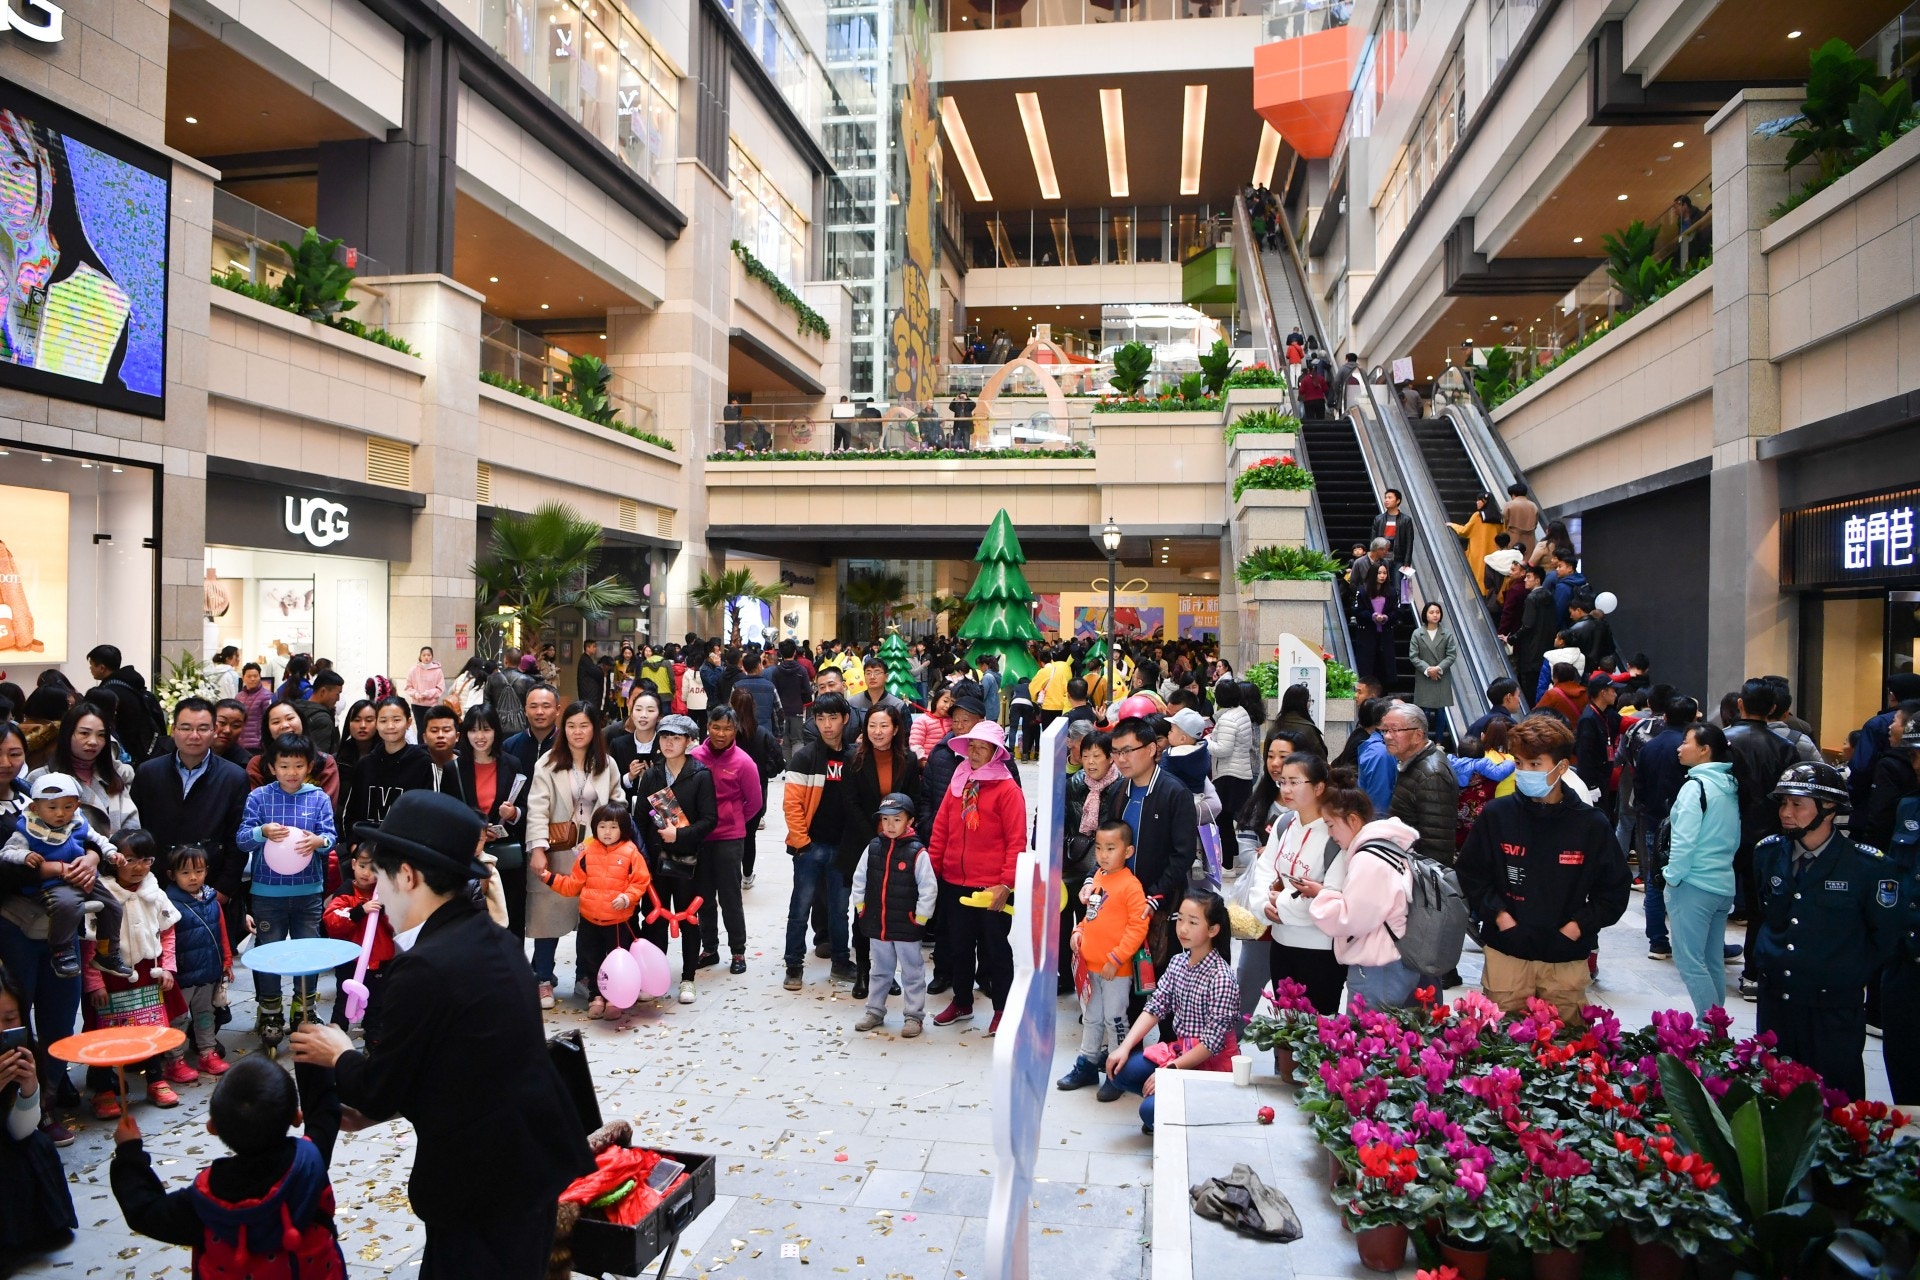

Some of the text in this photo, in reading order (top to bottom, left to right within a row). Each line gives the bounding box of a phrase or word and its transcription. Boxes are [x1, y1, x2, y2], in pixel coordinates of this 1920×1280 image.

[285, 495, 350, 548] UGG
[1844, 506, 1914, 570] 鹿角巷
